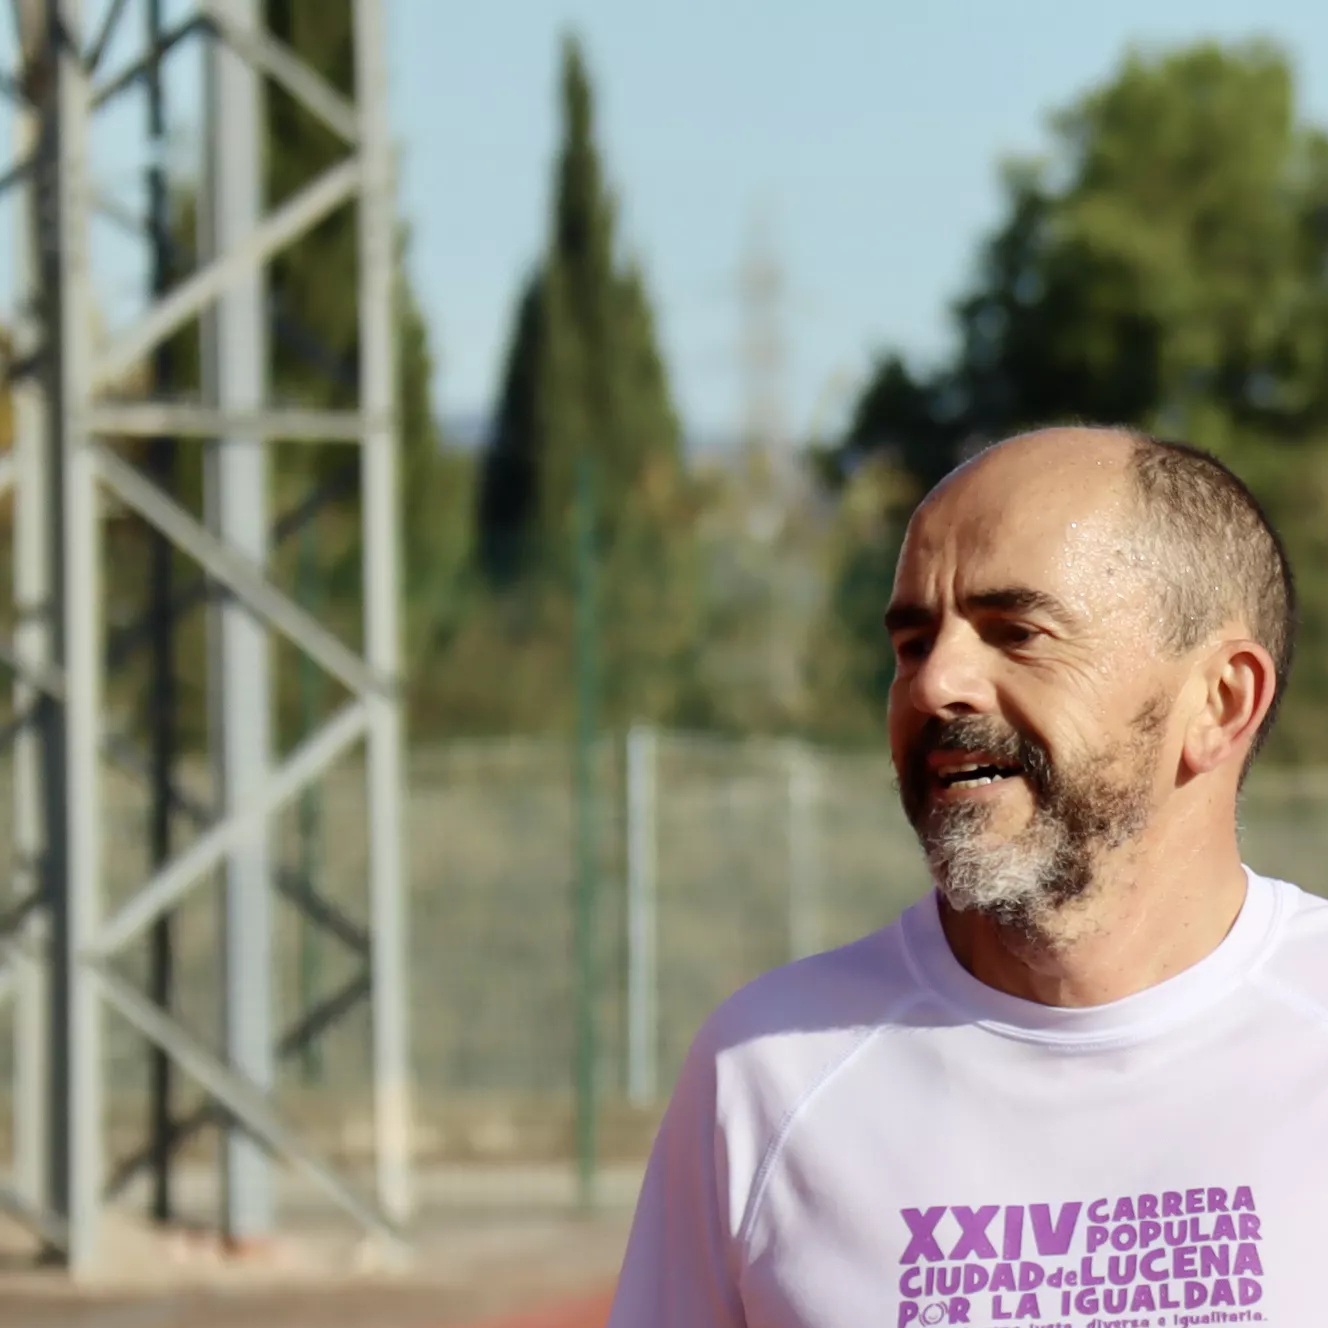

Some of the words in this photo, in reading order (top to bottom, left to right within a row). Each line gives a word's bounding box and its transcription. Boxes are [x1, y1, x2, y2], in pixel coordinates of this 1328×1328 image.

[899, 1201, 1083, 1265] XXIV
[1087, 1186, 1256, 1224] CARRERA
[1087, 1214, 1263, 1254] POPULAR
[899, 1260, 1046, 1298] CIUDAD
[1080, 1242, 1265, 1286] LUCENA
[991, 1292, 1041, 1321] LA
[1060, 1277, 1263, 1317] IGUALDAD
[1157, 1316, 1166, 1327] e
